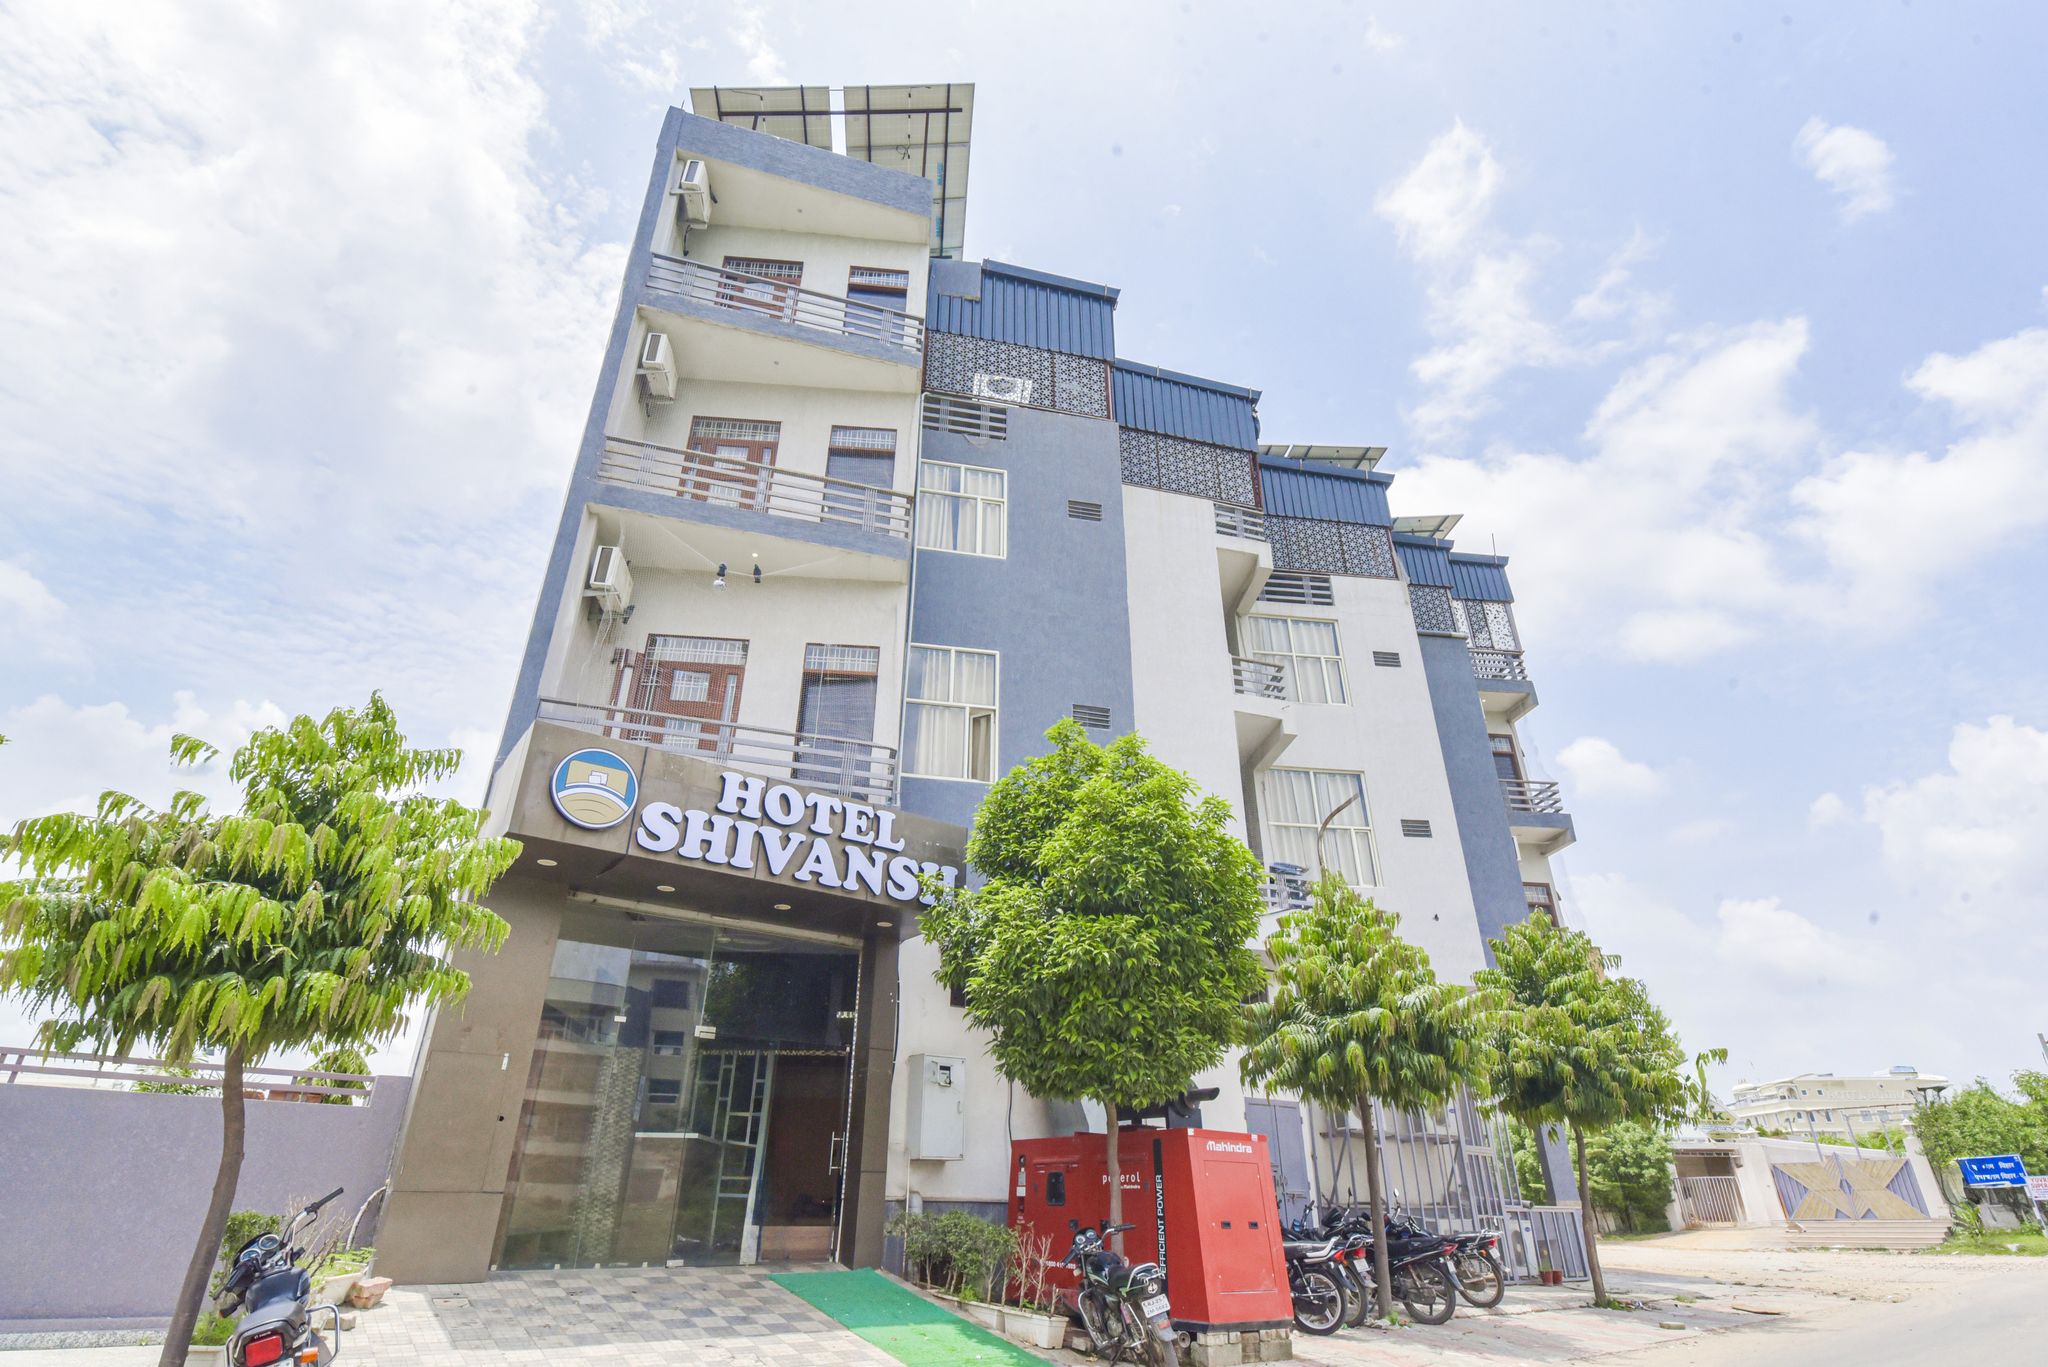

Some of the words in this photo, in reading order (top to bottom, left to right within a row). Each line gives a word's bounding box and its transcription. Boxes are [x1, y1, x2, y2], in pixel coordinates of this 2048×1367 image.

[717, 771, 905, 852] HOTEL
[636, 801, 958, 906] SHIVANSH
[1206, 1140, 1253, 1153] Mahindra
[1102, 1171, 1141, 1184] perol
[1155, 1175, 1164, 1216] POWER
[1157, 1218, 1167, 1274] EFFICIENT
